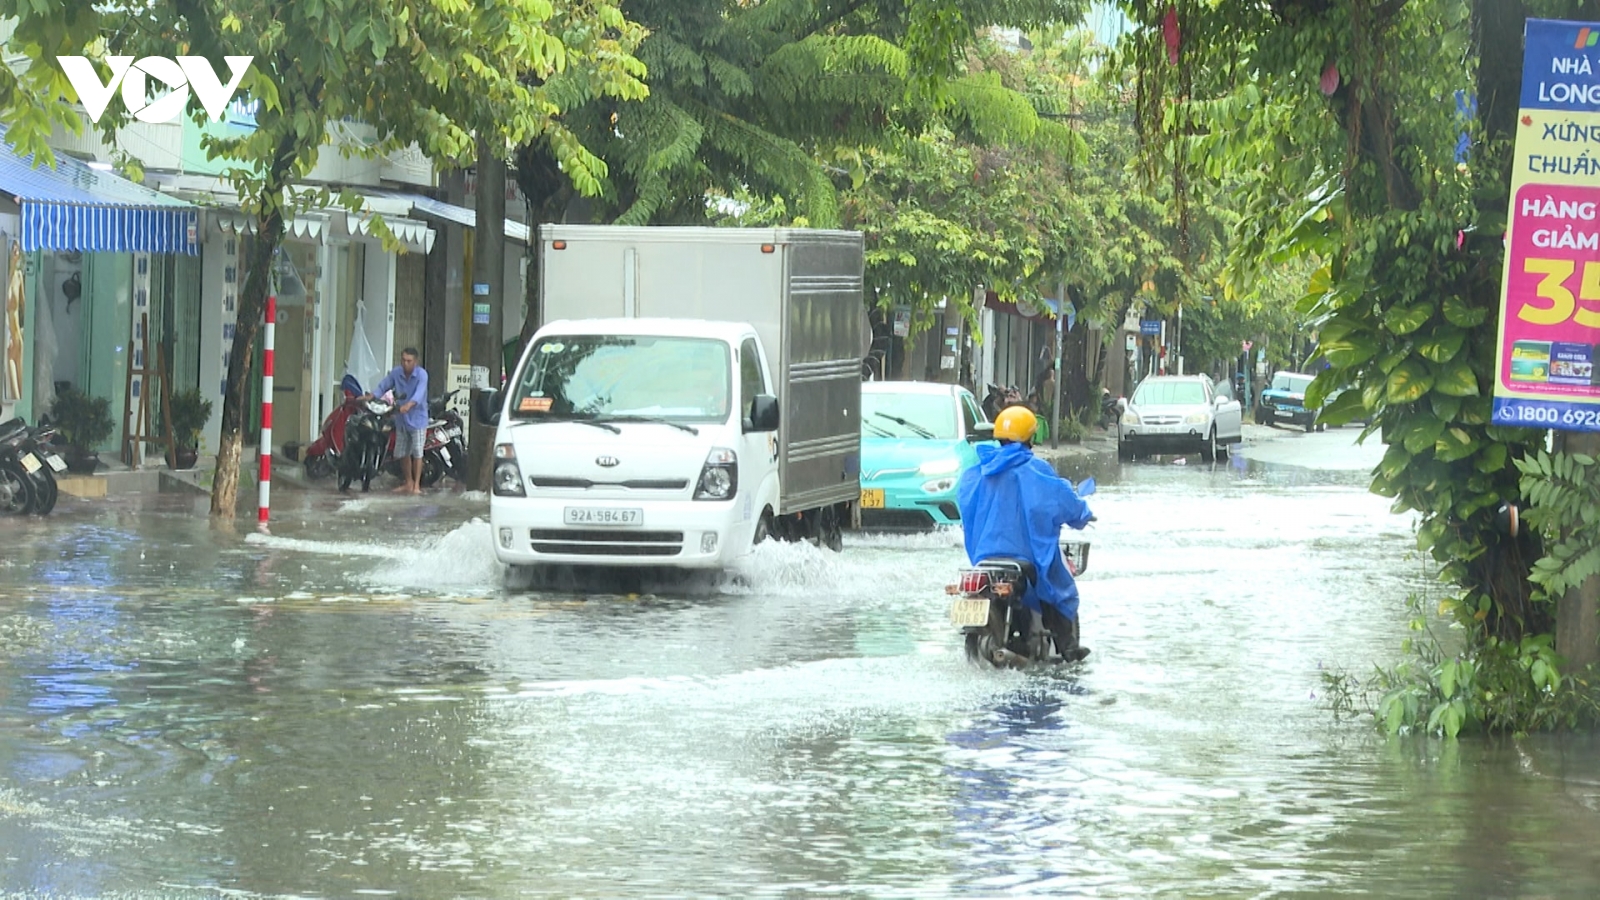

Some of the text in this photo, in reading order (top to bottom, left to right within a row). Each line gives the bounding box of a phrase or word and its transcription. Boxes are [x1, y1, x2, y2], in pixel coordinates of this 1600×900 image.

[1551, 54, 1593, 75] NHÀ
[1521, 194, 1597, 221] HÀNG
[1531, 224, 1599, 250] GIẢM
[1517, 405, 1558, 423] 1800
[599, 456, 617, 466] KIA
